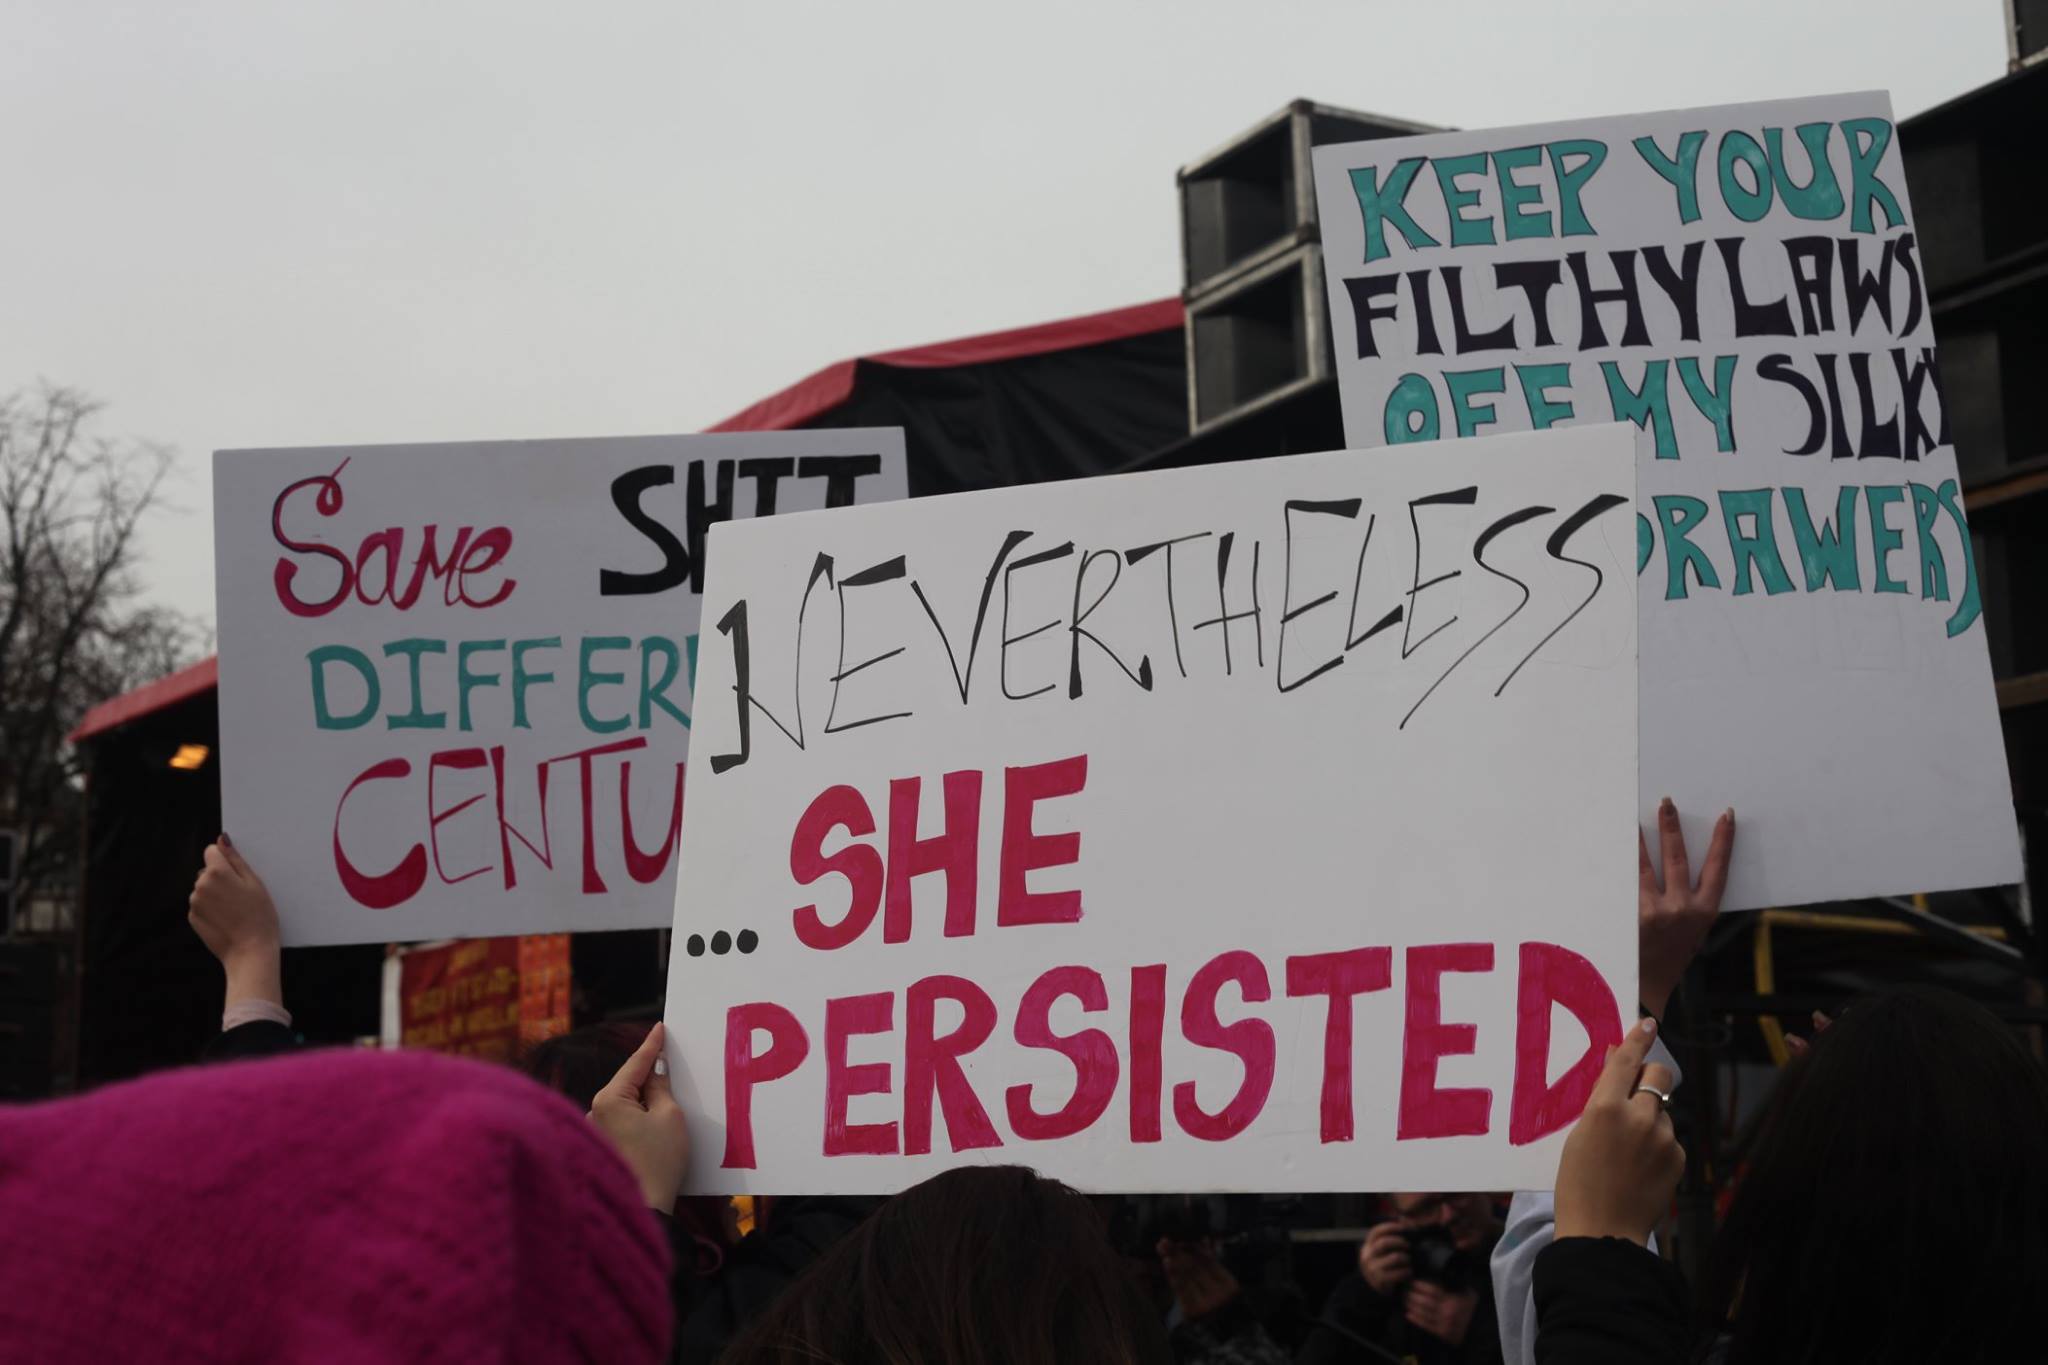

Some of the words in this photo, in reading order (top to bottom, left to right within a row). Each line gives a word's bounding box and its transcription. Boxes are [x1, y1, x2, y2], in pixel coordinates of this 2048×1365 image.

[1347, 139, 1607, 263] KEEP
[1632, 117, 1907, 234] YOUR
[1343, 241, 1705, 359] FILTHY
[1714, 233, 1923, 339] LAWS
[1384, 361, 1575, 446] OFF
[1599, 354, 1738, 460] MY
[305, 634, 699, 733] DIFFER
[711, 486, 1629, 773] NEVERTHELESS
[333, 737, 685, 909] CENTU
[790, 755, 1088, 950] SHE
[720, 942, 1624, 1168] PERSISTED
